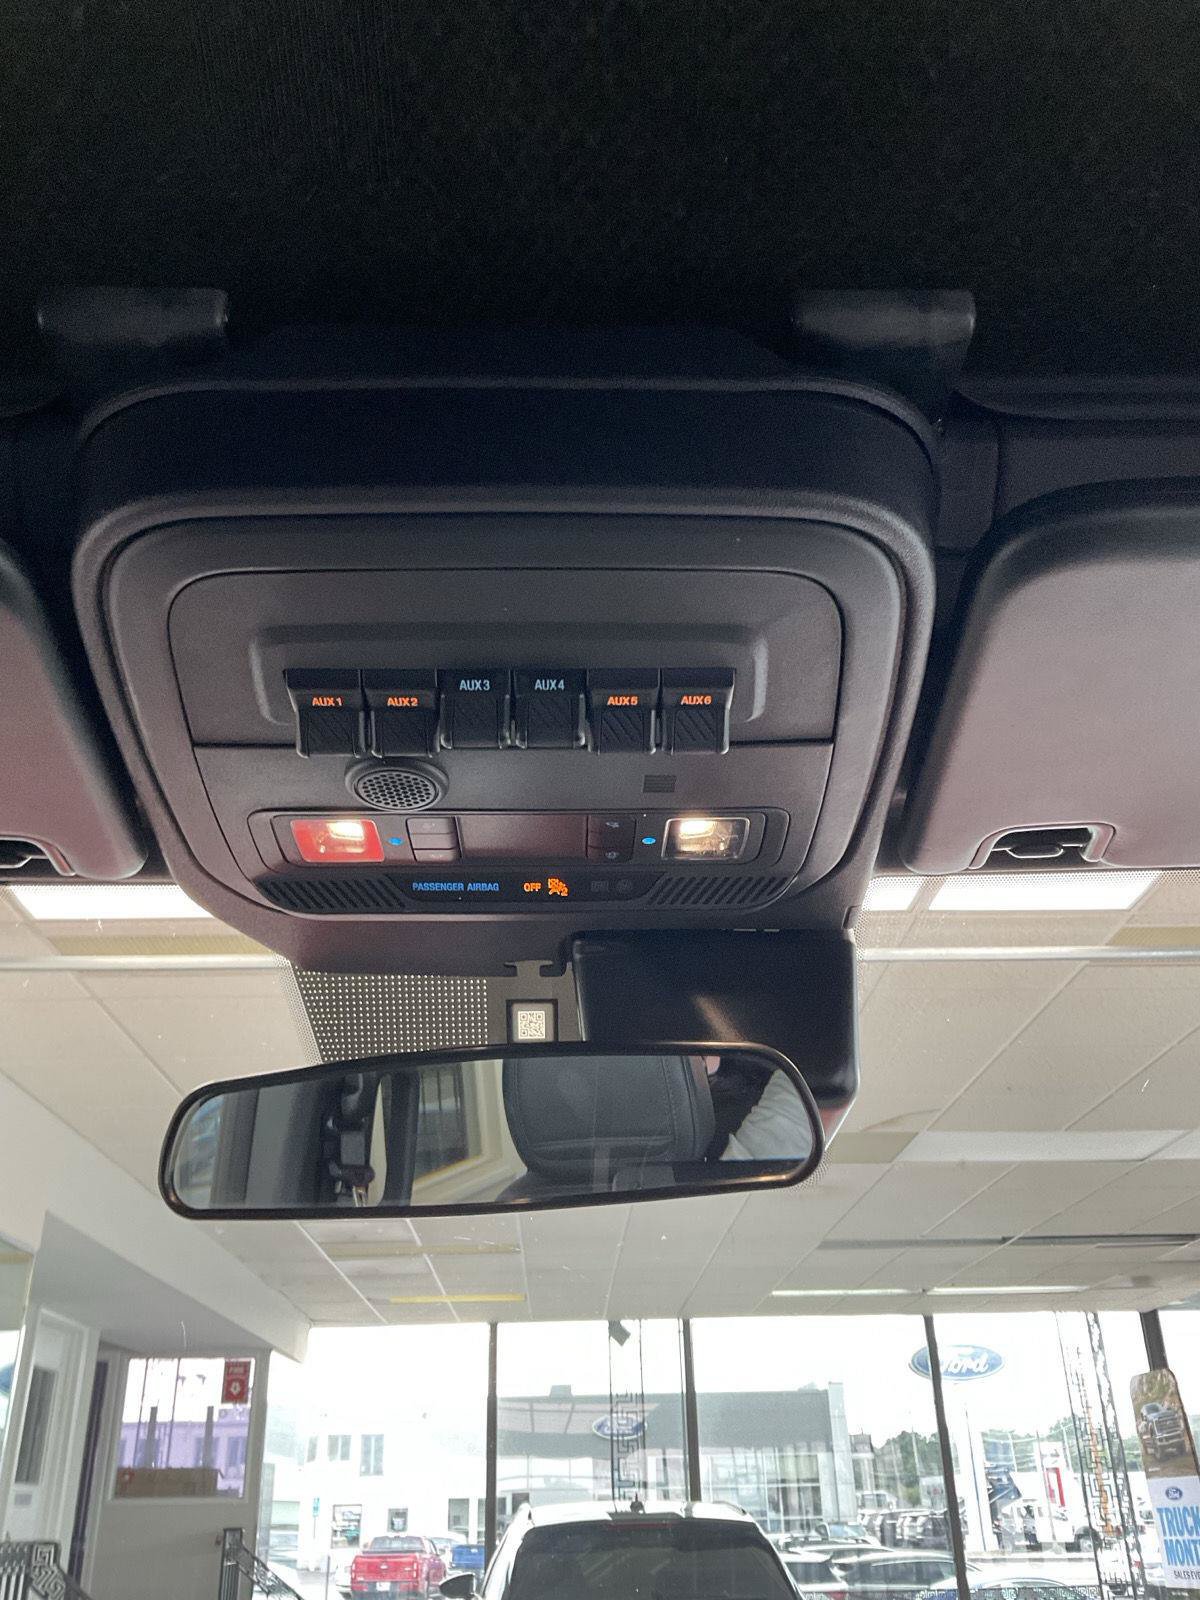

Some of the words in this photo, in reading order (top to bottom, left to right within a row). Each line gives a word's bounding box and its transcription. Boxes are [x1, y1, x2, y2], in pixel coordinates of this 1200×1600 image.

[412, 882, 465, 892] PASSENGER
[466, 882, 500, 892] AIRBAG
[523, 882, 542, 892] OFF
